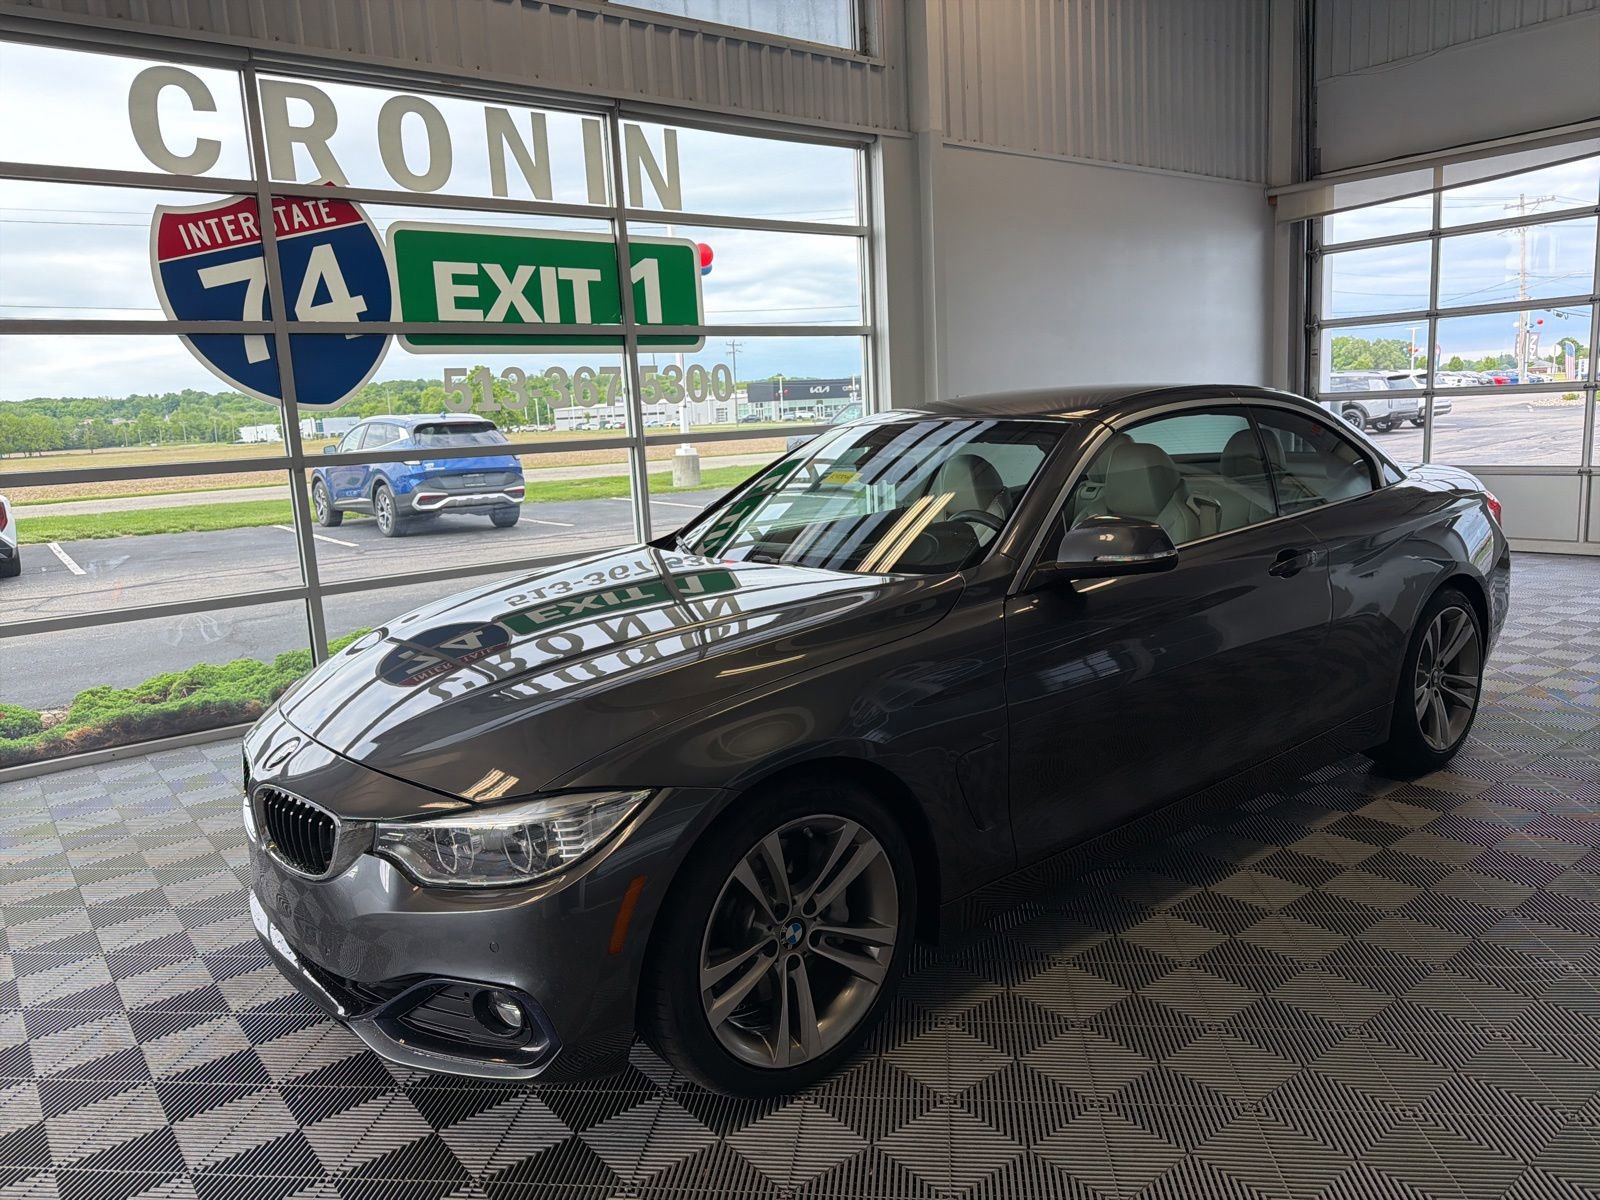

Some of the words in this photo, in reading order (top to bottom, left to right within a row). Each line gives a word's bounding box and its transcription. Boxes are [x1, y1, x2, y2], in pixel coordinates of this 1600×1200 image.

[128, 66, 682, 210] CRONIN
[178, 199, 337, 250] INTERTATE
[197, 243, 368, 364] 74
[432, 260, 601, 324] EXIT
[630, 258, 663, 324] 1
[443, 363, 734, 412] 513-3675300
